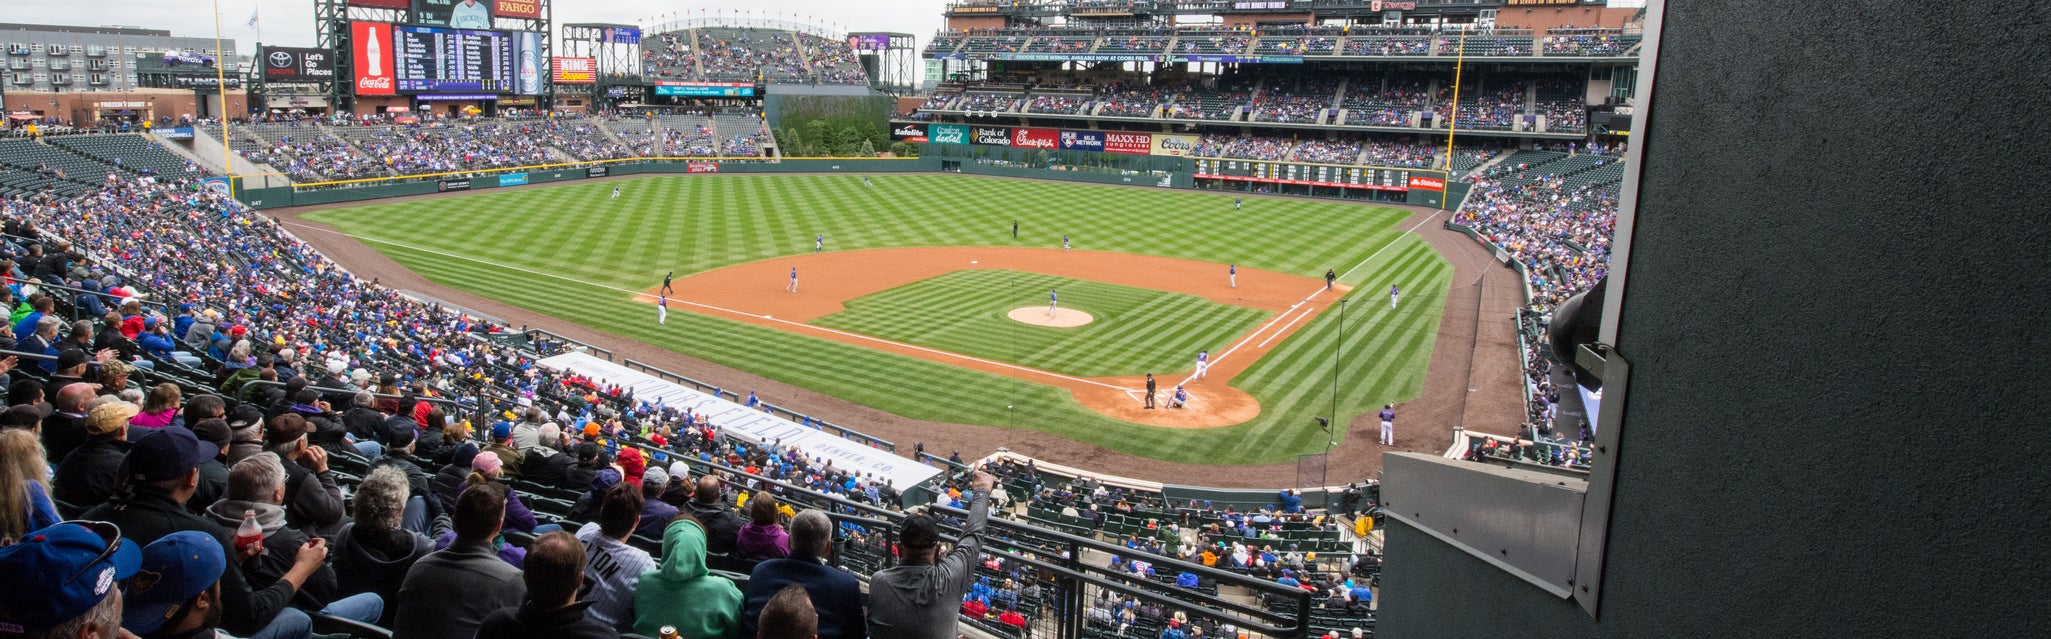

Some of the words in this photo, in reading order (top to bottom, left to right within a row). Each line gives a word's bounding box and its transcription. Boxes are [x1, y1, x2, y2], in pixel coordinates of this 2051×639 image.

[499, 2, 535, 13] FARGO
[178, 56, 203, 64] TOYOTA
[561, 59, 589, 71] KING
[306, 68, 332, 76] Places
[894, 128, 923, 136] Safelite
[979, 128, 993, 137] Bank
[995, 129, 1005, 137] of
[979, 136, 1011, 145] Colorado
[1106, 134, 1134, 143] MAXX
[1135, 135, 1150, 144] HD
[1161, 138, 1190, 150] Coors
